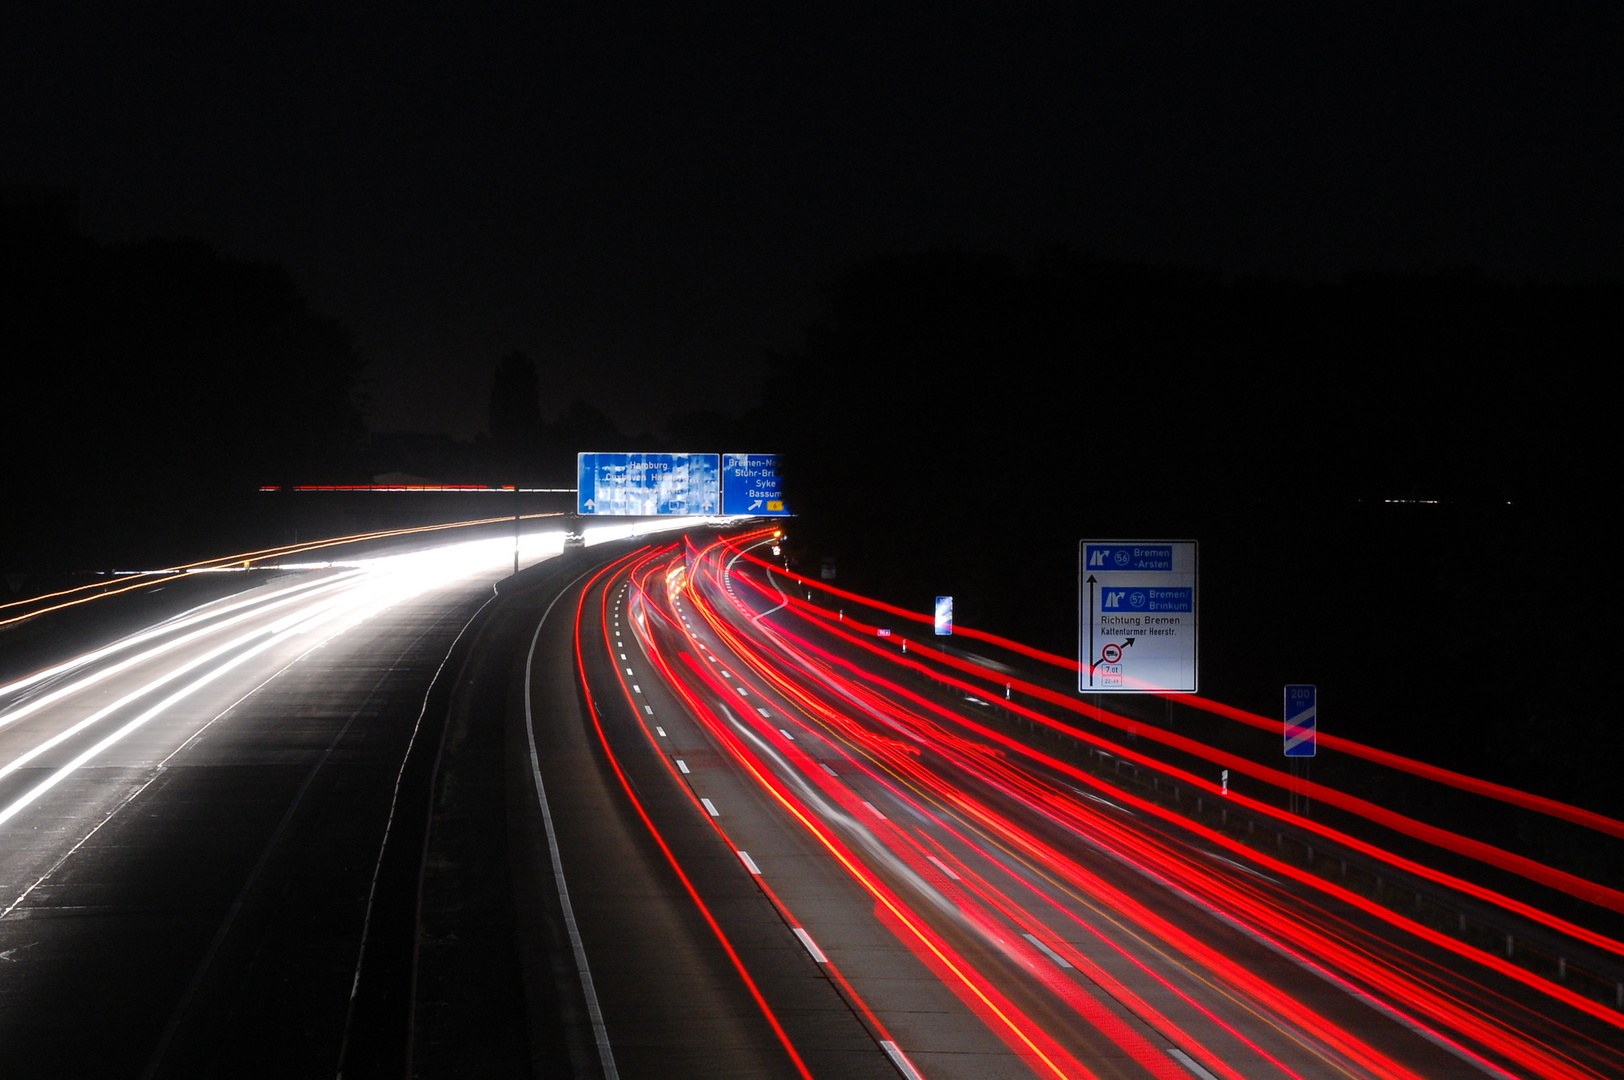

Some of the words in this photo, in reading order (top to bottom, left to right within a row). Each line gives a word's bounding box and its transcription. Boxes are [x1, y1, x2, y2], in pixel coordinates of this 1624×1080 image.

[630, 461, 668, 471] Hamburg
[729, 459, 777, 467] Bremen-N
[756, 479, 776, 489] Syke
[749, 489, 782, 498] Bassum
[1134, 548, 1170, 557] Bremen
[1117, 554, 1128, 563] 56
[1134, 560, 1169, 568] -Arsten
[1149, 590, 1189, 599] Bremen/
[1132, 595, 1143, 604] 57
[1149, 601, 1188, 610] Brinkum
[1101, 615, 1141, 626] Richtung
[1144, 615, 1180, 624] Bremen
[1100, 627, 1146, 636] Kattenturmer
[1149, 627, 1177, 636] Heerstr.
[1291, 688, 1310, 699] 200
